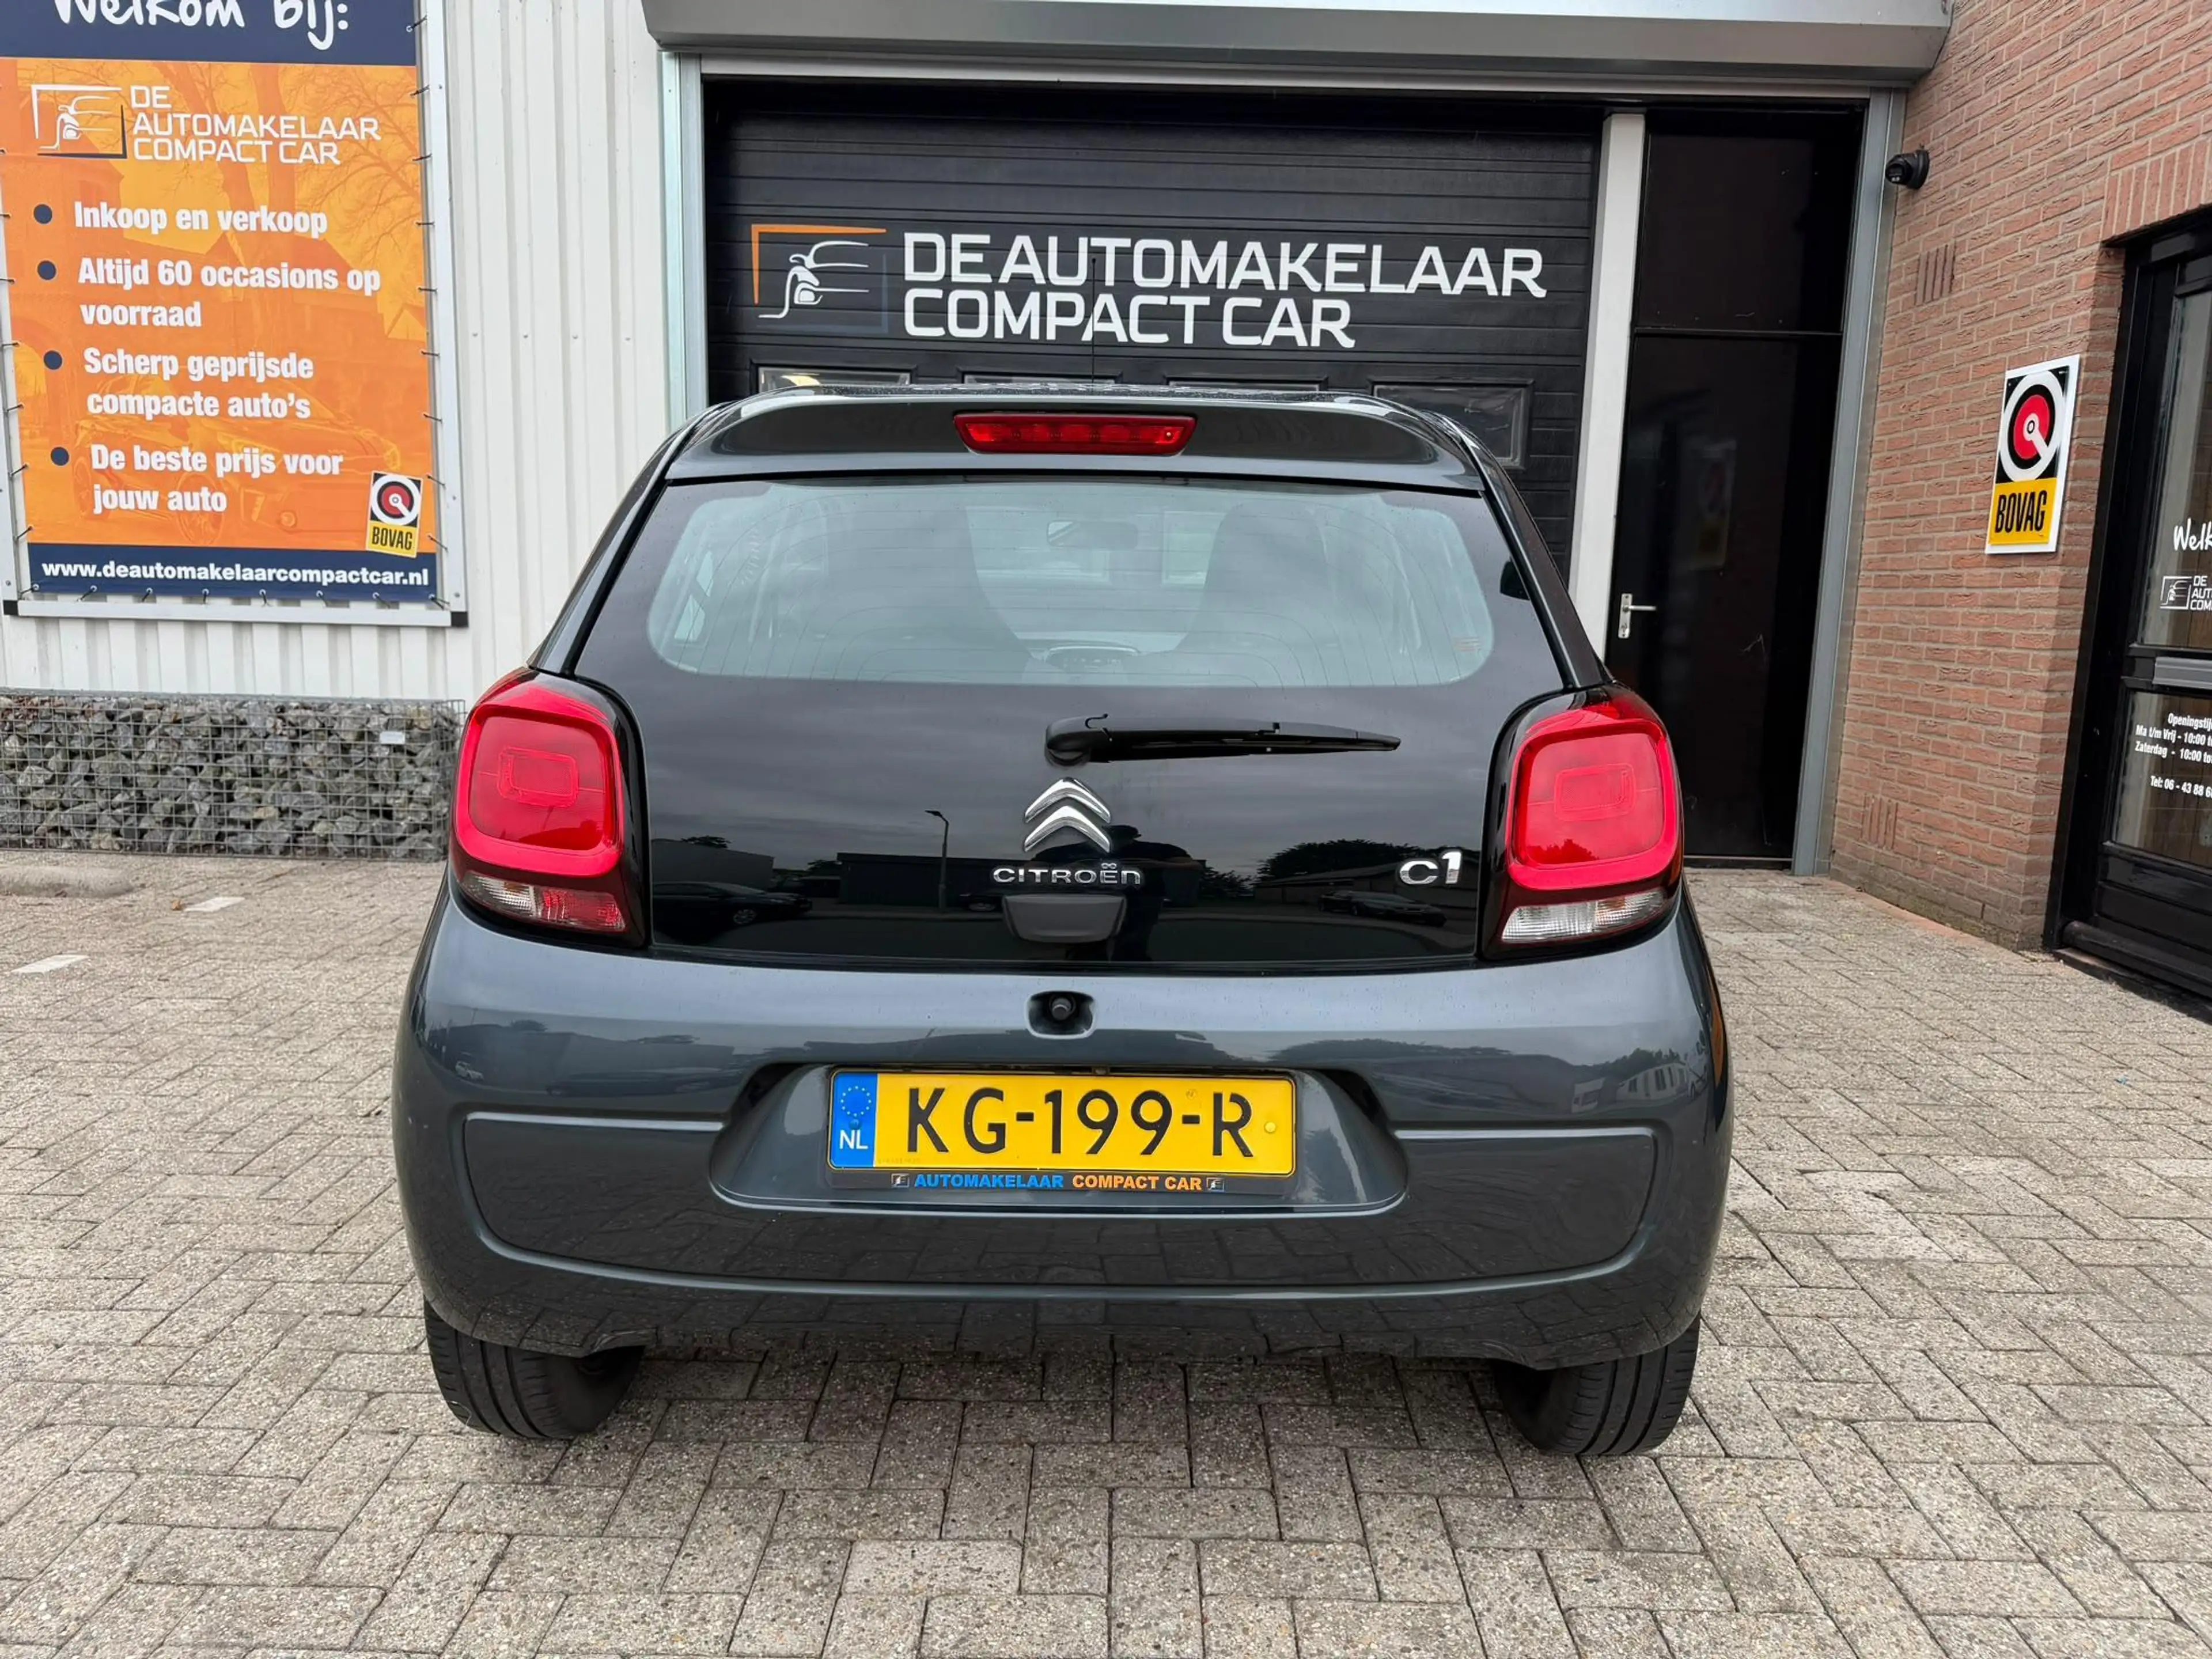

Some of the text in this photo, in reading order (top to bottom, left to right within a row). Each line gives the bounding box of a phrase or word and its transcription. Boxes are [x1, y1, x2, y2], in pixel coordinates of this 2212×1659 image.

[130, 85, 172, 108] DE
[133, 112, 381, 141] AUTOMAKELAAR
[134, 138, 340, 165] COMPACT CAR
[74, 202, 328, 238] Inkoop en verkoop
[78, 257, 380, 296] Altijd 60 occasions op
[904, 233, 1547, 298] DE AUTOMAKELAAR
[80, 301, 201, 327] voorraad
[904, 288, 1355, 348] COMPACT CAR
[84, 347, 313, 382] Scherp geprijsde
[87, 391, 310, 420] compacte auto’s
[91, 444, 343, 478] De beste prijs voor
[93, 484, 228, 514] jouw auto
[1995, 490, 2047, 533] BOVAG
[372, 527, 412, 550] BOVAG
[42, 560, 428, 586] www.deautomakelaarcompactcar.nl
[2194, 575, 2208, 586] DE
[2190, 599, 2212, 611] COM
[2191, 588, 2212, 599] AUT
[2135, 725, 2147, 736] Ma
[2149, 726, 2162, 738] t/m
[2163, 729, 2176, 743] Vrij
[2184, 732, 2206, 745] 10:00
[2135, 741, 2168, 758] Zaterdag
[2180, 748, 2202, 762] 10:00
[2150, 775, 2163, 789] Tel:
[2164, 778, 2175, 790] 06
[2181, 782, 2192, 794] 43
[2193, 784, 2204, 796] 88
[2206, 786, 2212, 798] 6
[1400, 851, 1461, 884] C1
[906, 1087, 1254, 1158] KG-199-R
[839, 1130, 869, 1149] NL
[915, 1174, 1202, 1191] AUTOMAKELAAR COMPACT CAR
